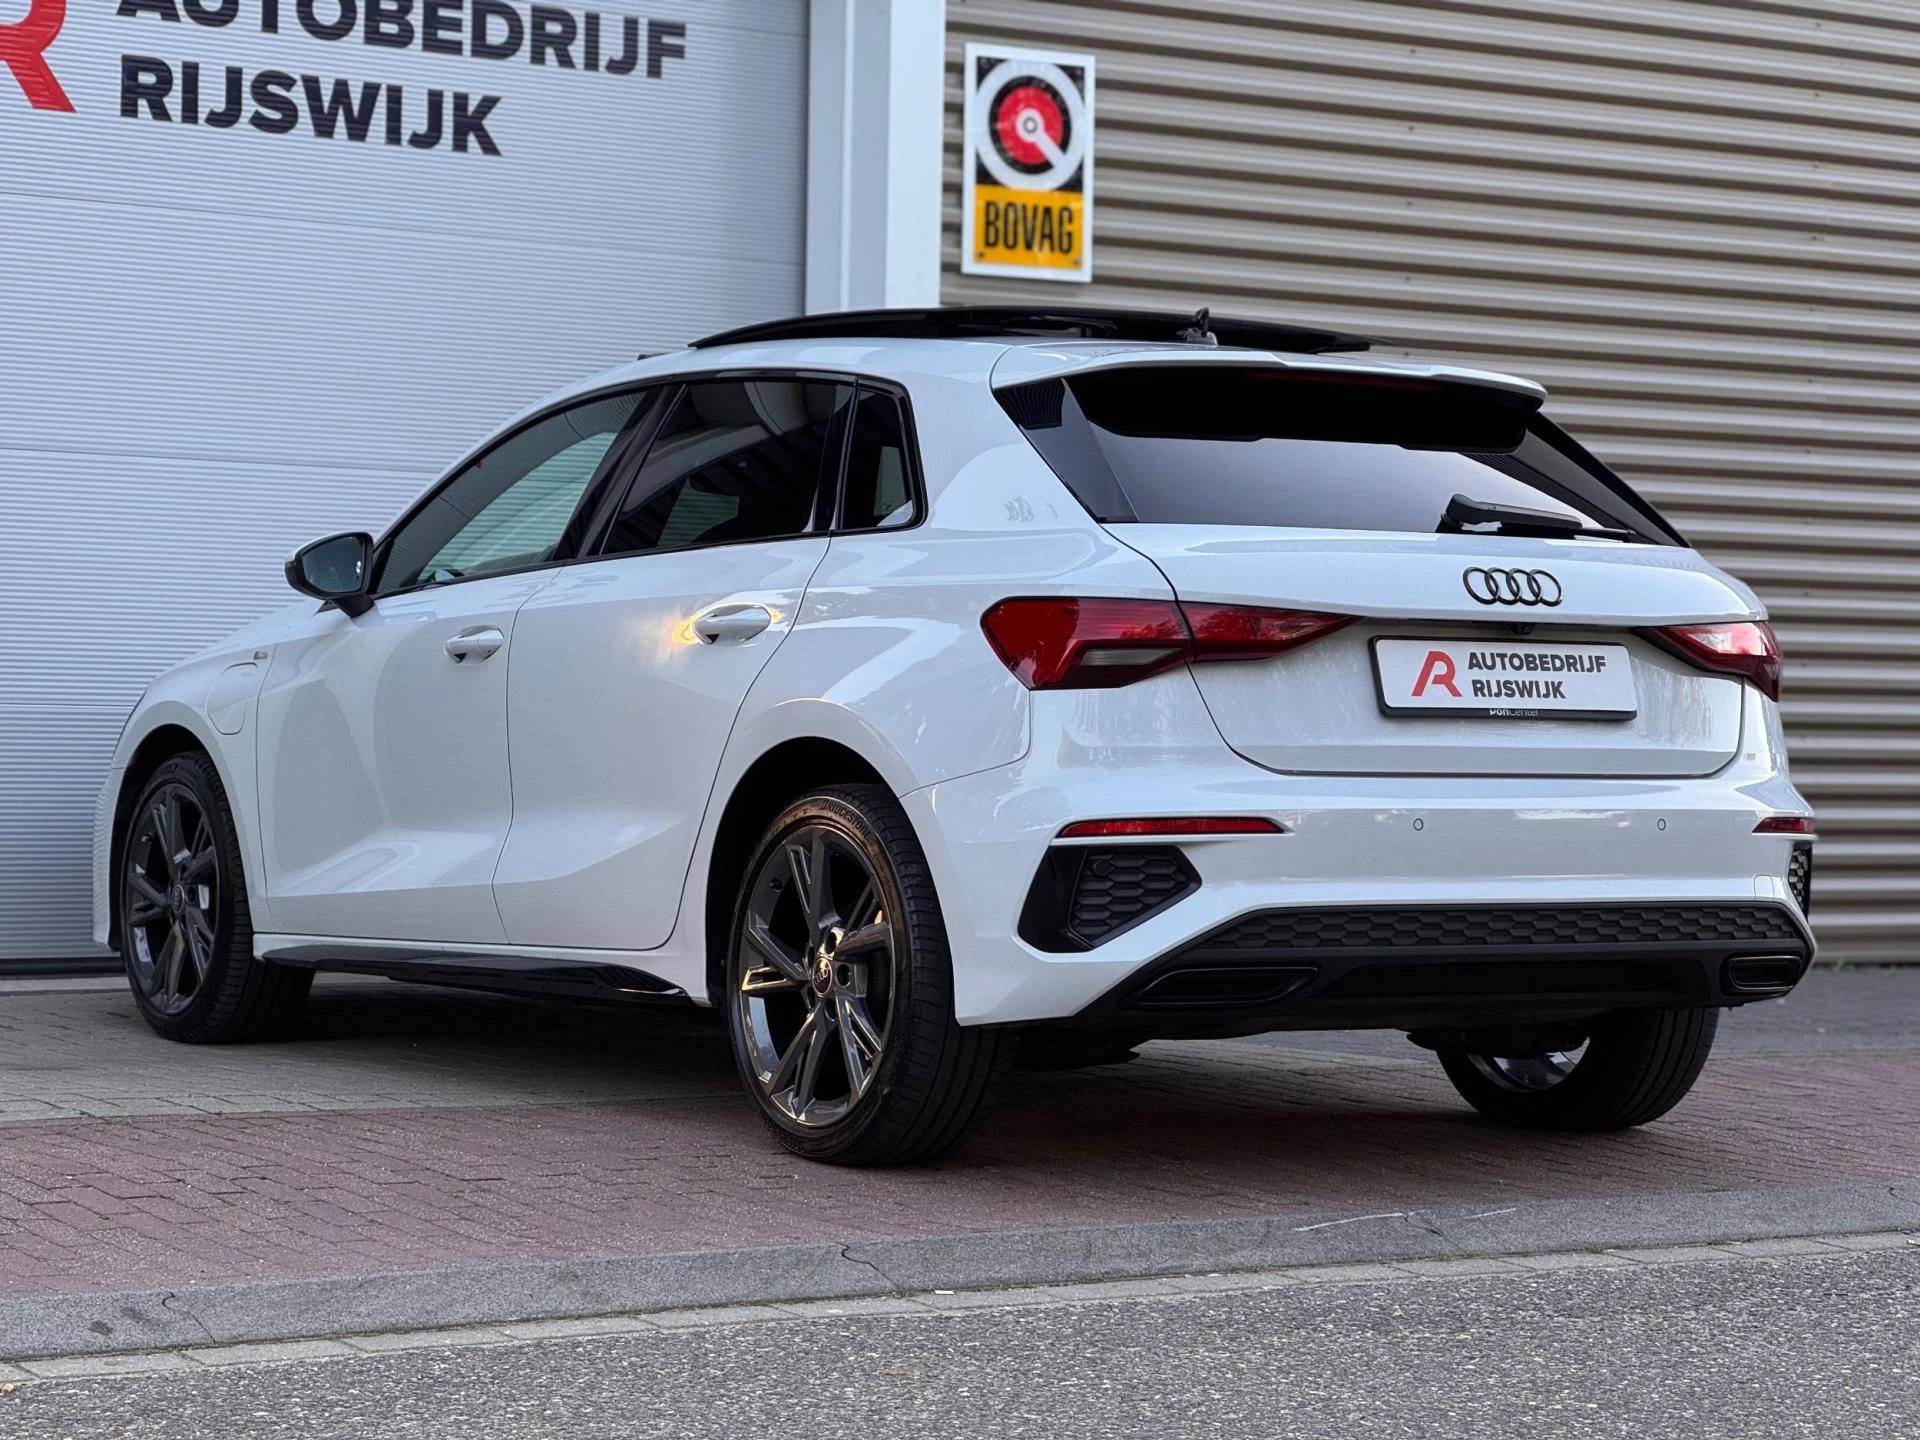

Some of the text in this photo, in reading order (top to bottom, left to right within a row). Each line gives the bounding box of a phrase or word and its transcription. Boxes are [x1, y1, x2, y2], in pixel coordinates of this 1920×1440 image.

[120, 54, 502, 157] RIJSWIJK
[984, 200, 1073, 254] BOVAG
[1468, 652, 1606, 673] AUTOBEDRIJF
[1472, 679, 1566, 699] RIJSWIJK
